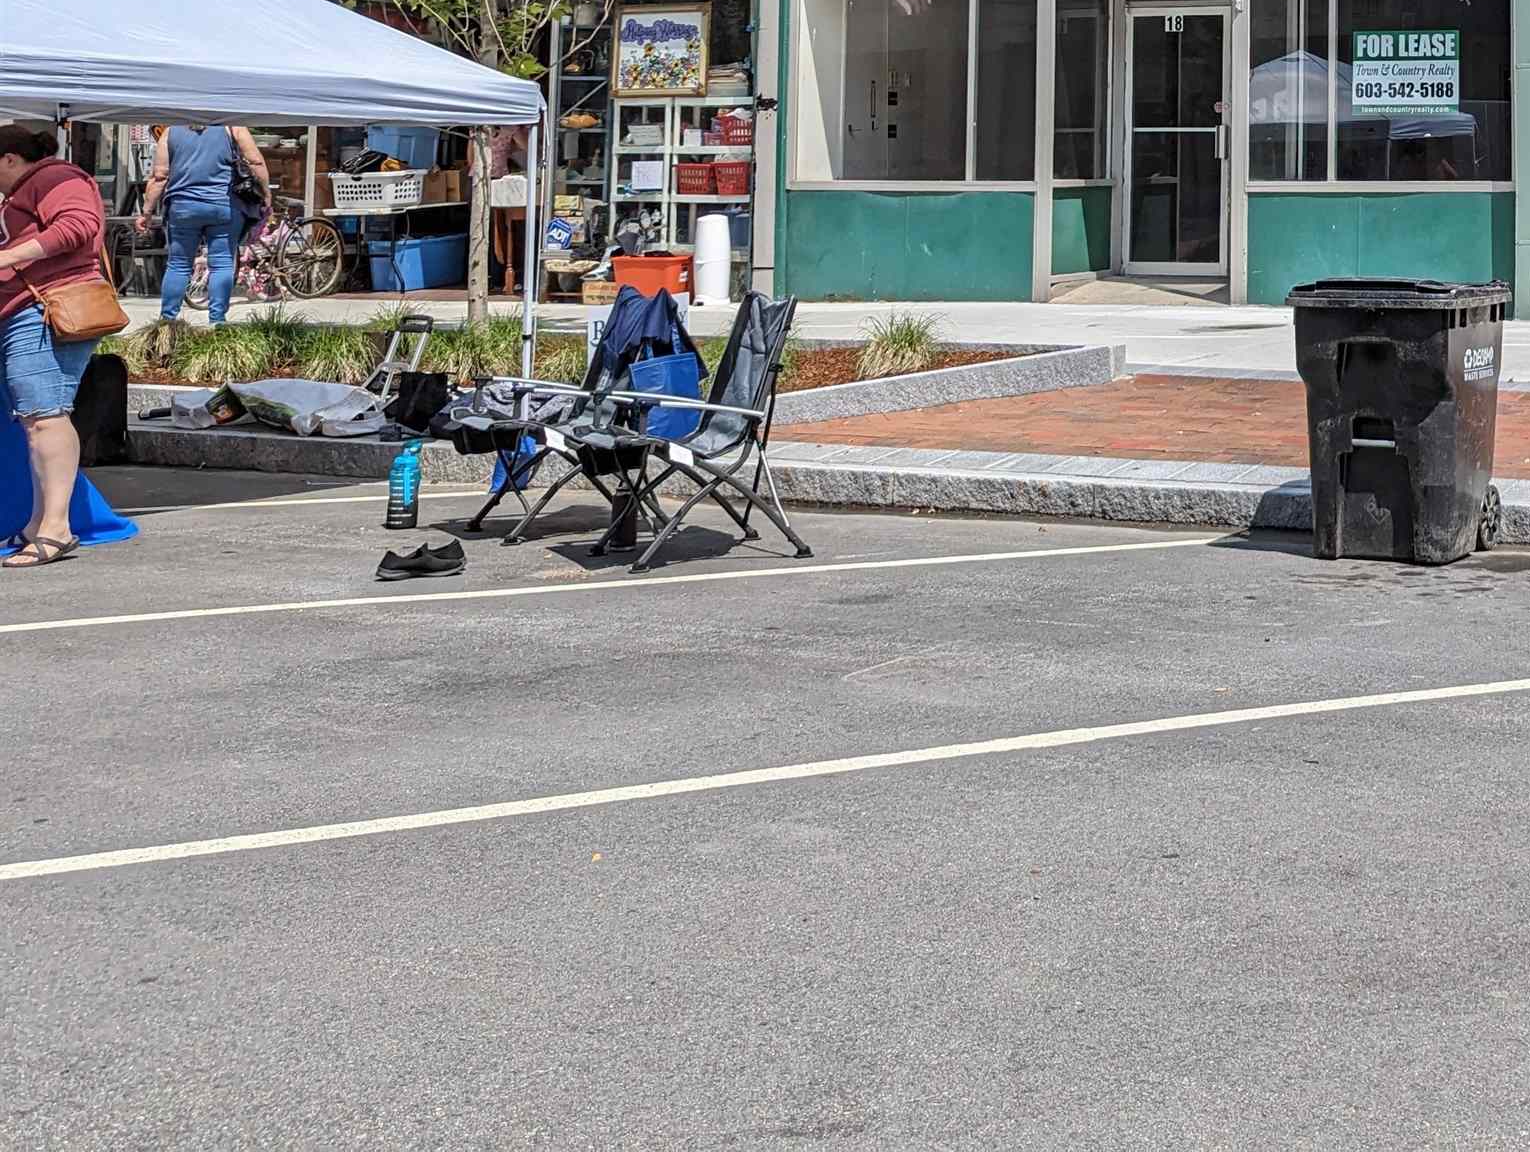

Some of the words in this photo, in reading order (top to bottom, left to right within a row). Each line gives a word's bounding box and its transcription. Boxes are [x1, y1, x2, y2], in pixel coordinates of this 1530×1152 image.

[1167, 16, 1183, 31] 18
[1357, 34, 1394, 57] FOR
[1398, 33, 1456, 57] LEASE
[1356, 64, 1379, 76] Town
[1381, 64, 1391, 76] &
[1392, 64, 1427, 80] Country
[1428, 63, 1456, 80] Realty
[1355, 82, 1454, 98] 603-542-5188
[550, 228, 571, 243] ADT
